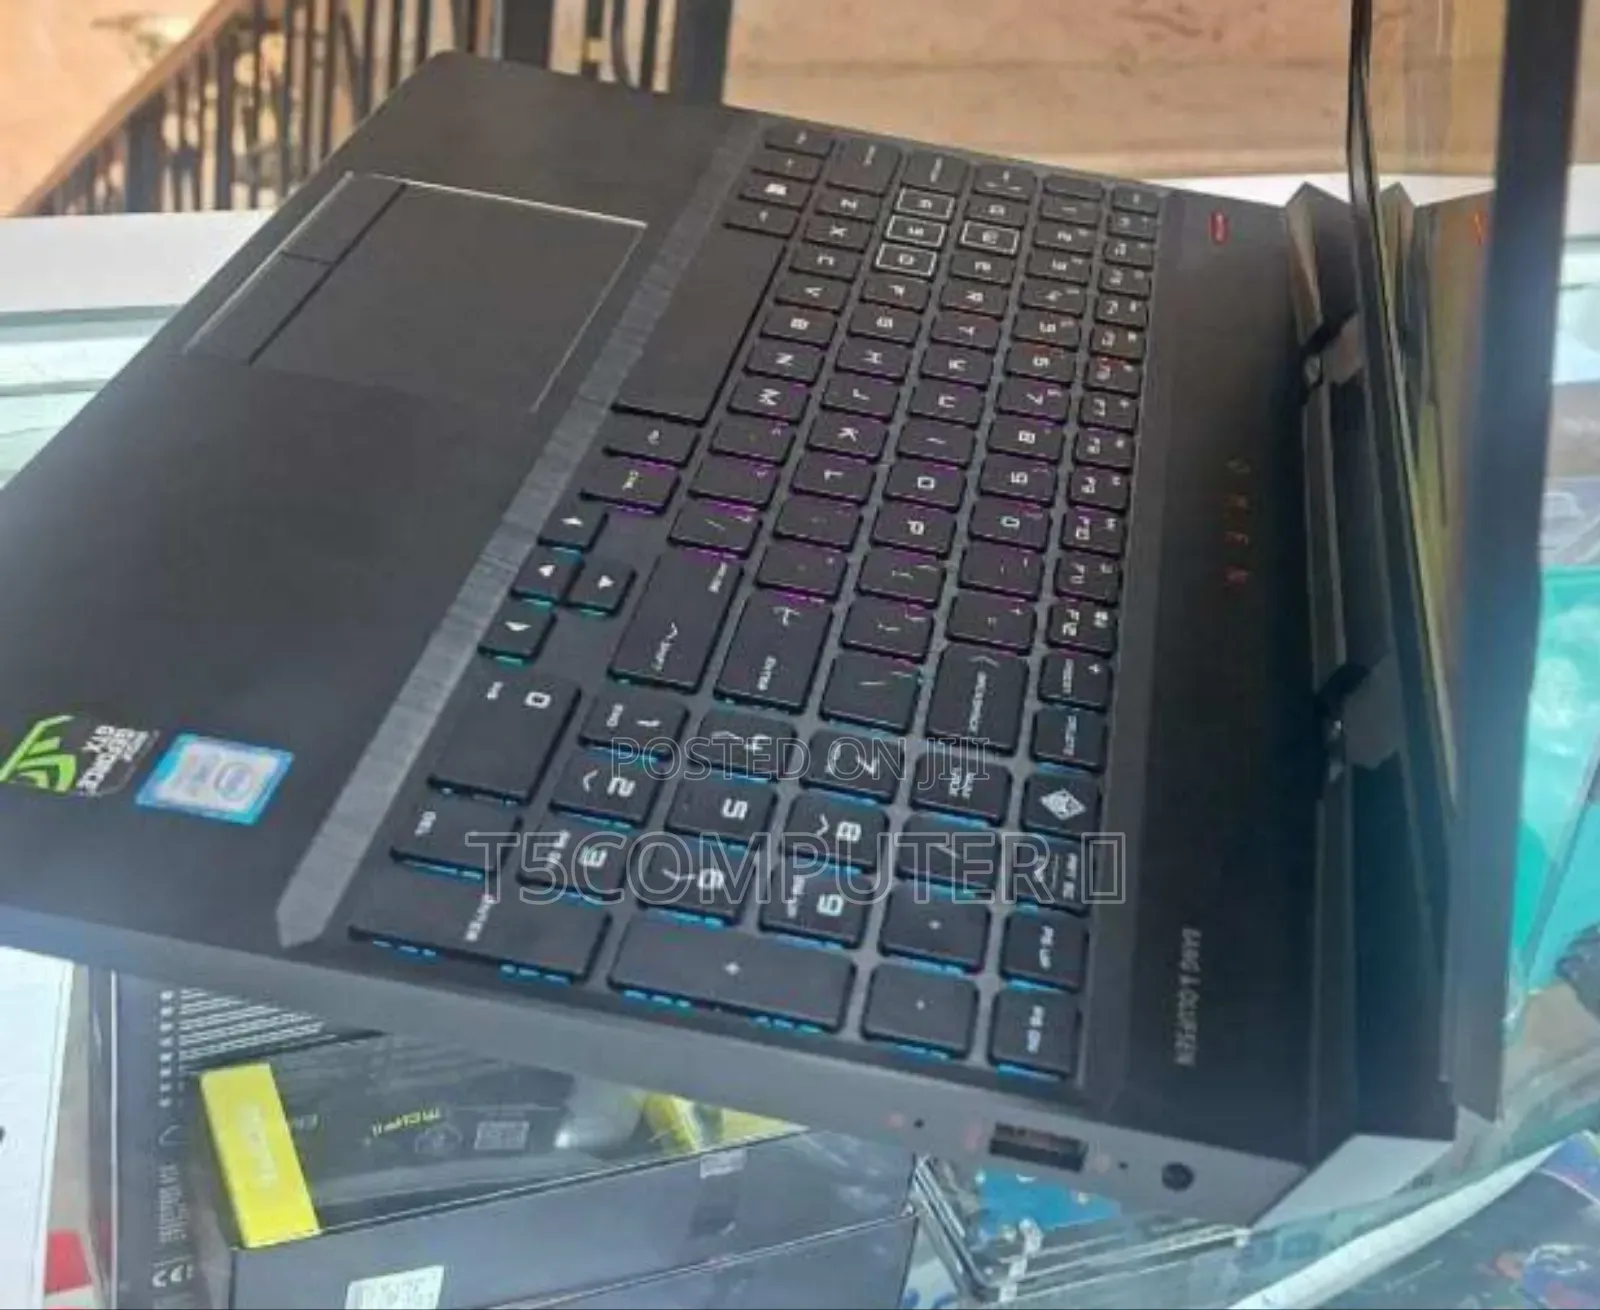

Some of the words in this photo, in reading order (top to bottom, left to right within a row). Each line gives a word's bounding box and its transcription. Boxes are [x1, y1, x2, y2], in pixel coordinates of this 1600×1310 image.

[829, 225, 848, 237] X
[805, 287, 823, 298] V
[966, 291, 984, 303] R
[790, 317, 810, 330] B
[958, 326, 976, 337] T
[775, 353, 794, 366] N
[864, 350, 882, 365] H
[758, 388, 781, 406] M
[852, 388, 870, 401] J
[937, 395, 956, 409] U
[1026, 393, 1044, 406] 7
[1094, 398, 1106, 417] F7
[838, 427, 859, 442] K
[823, 469, 844, 481] L
[1081, 476, 1097, 494] F9
[907, 520, 925, 536] P
[1000, 515, 1021, 529] 0
[1074, 518, 1091, 541] F10
[1062, 608, 1080, 637] F12
[525, 691, 551, 709] 0
[607, 777, 637, 798] 2
[721, 798, 748, 820] 5
[835, 821, 862, 842] 8
